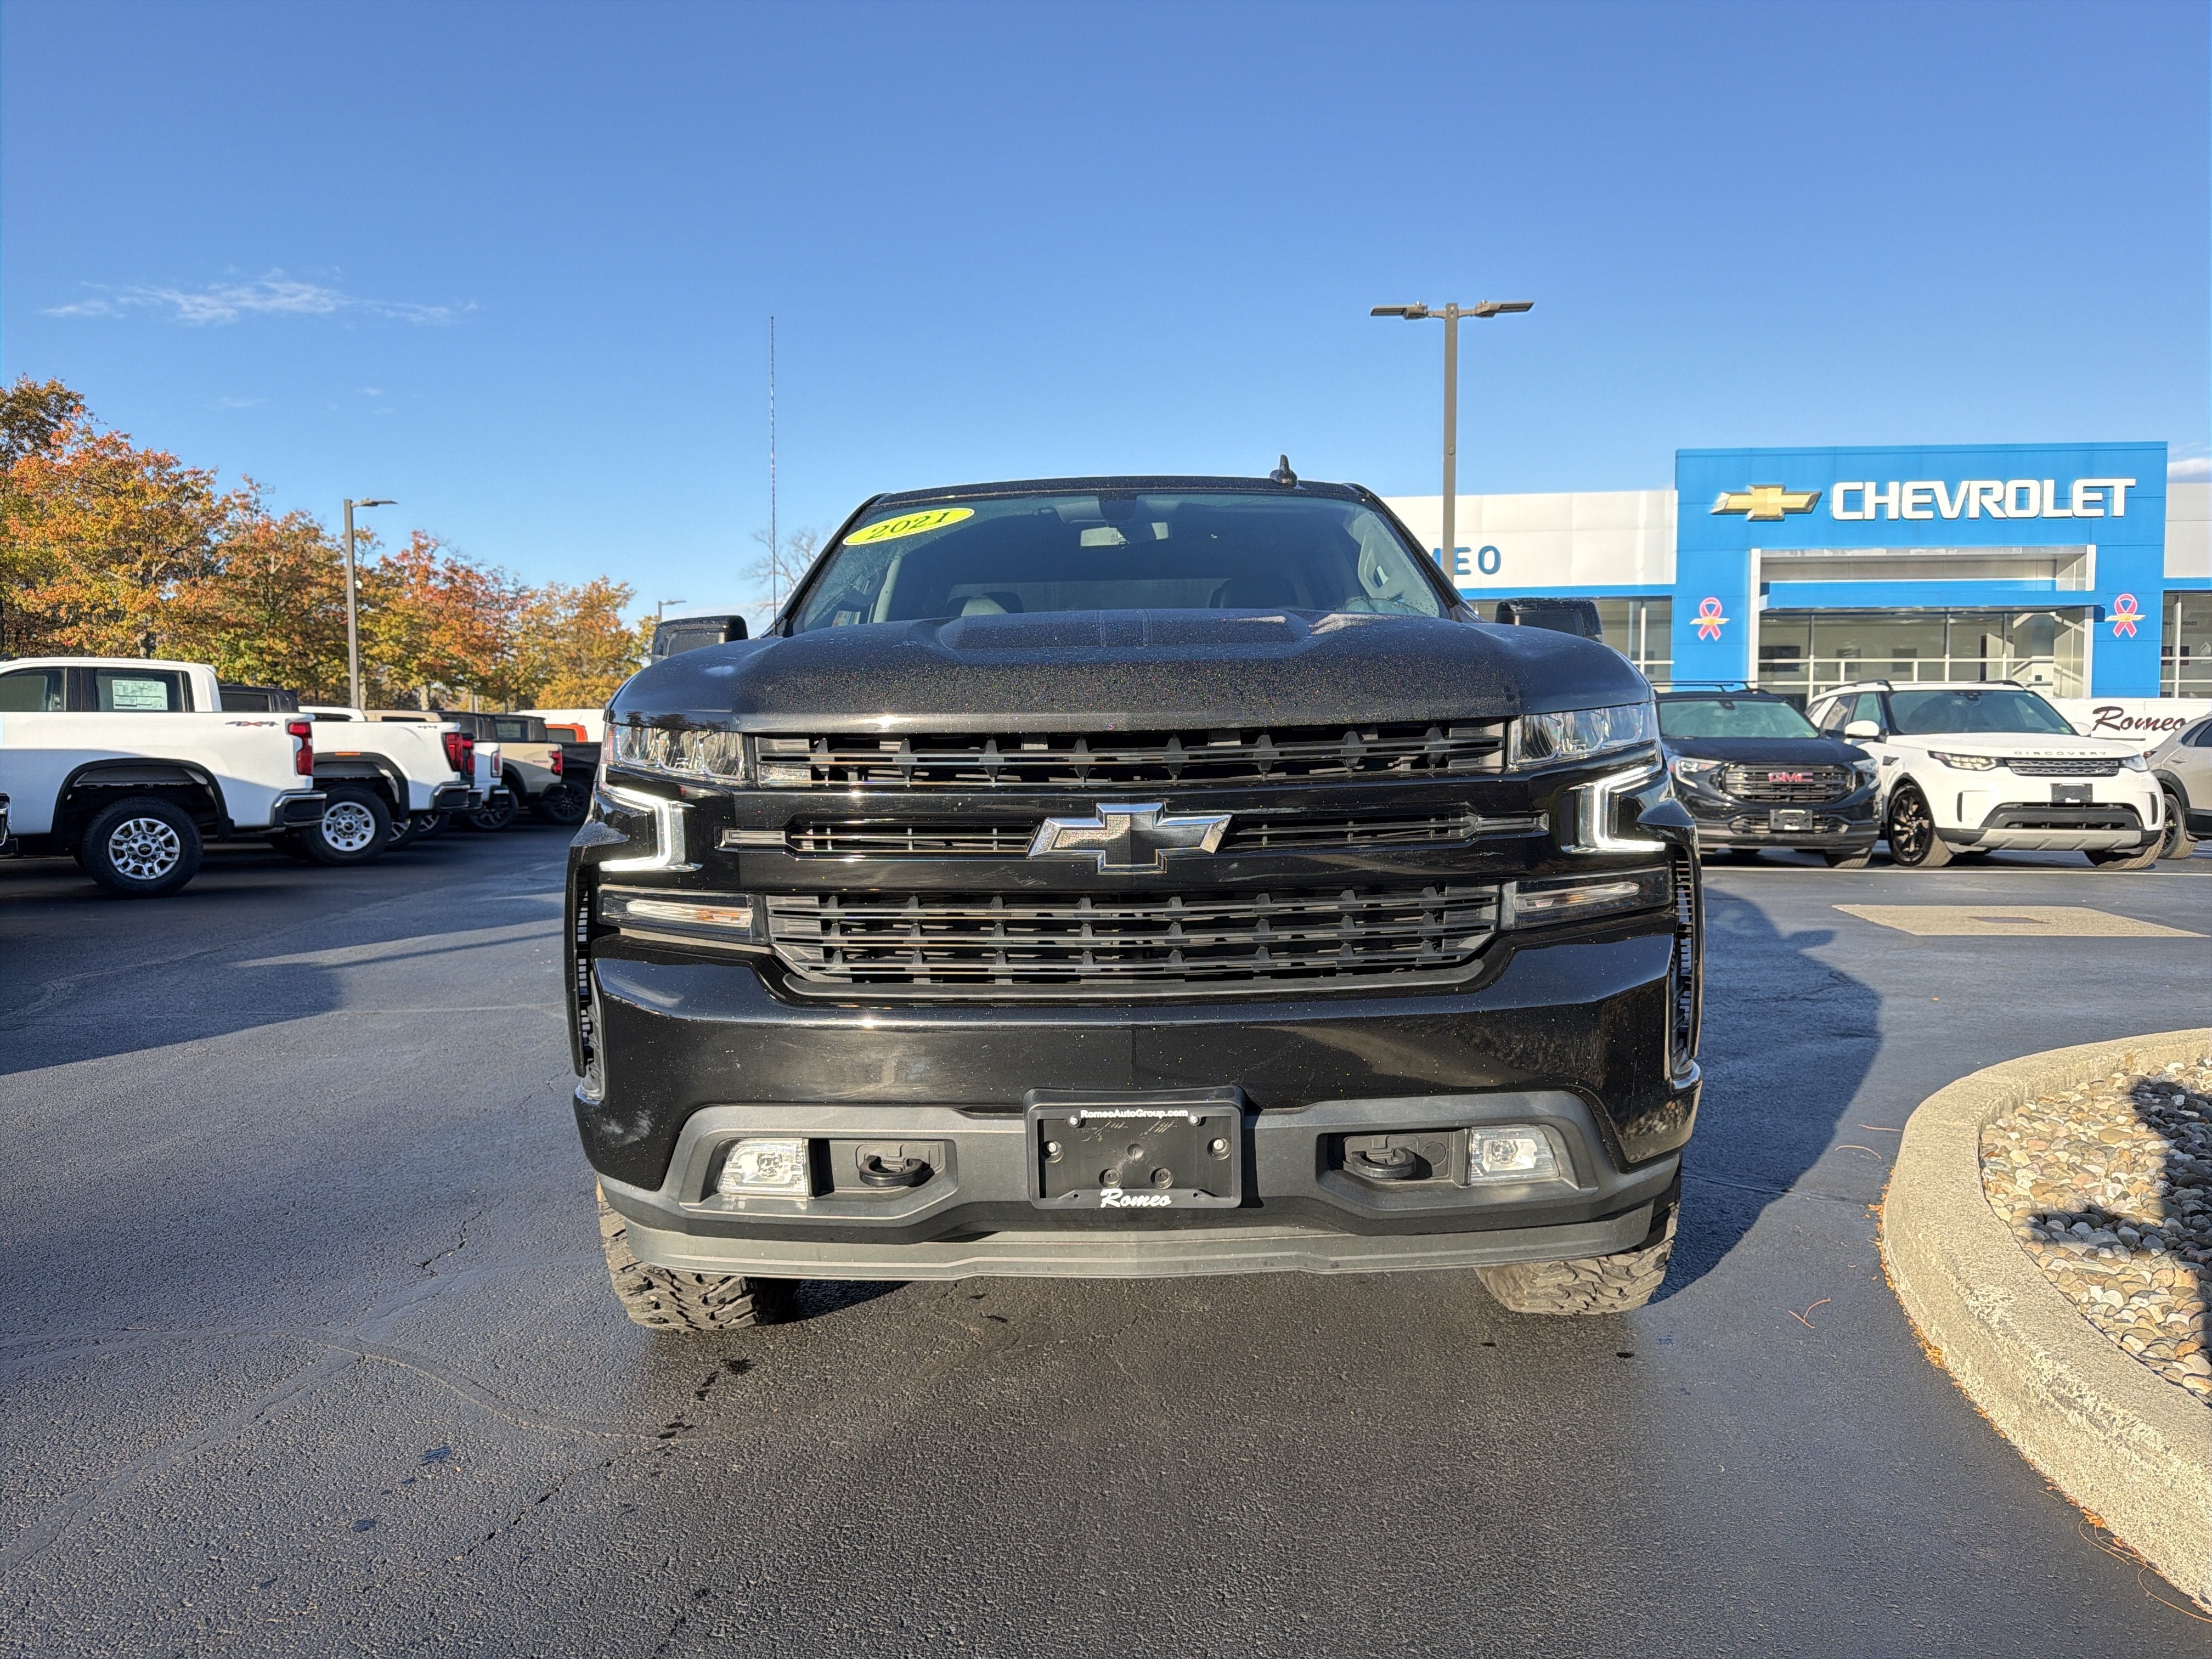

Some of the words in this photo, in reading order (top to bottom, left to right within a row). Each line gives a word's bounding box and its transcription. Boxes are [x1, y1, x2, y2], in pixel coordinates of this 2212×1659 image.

[1831, 477, 2136, 521] CHEVROLET
[866, 511, 950, 540] 2021
[2092, 706, 2186, 731] Romeo
[1768, 772, 1814, 782] GMC
[1080, 1109, 1188, 1119] RomeoAutoGroup.com
[1100, 1188, 1172, 1208] Romeo
